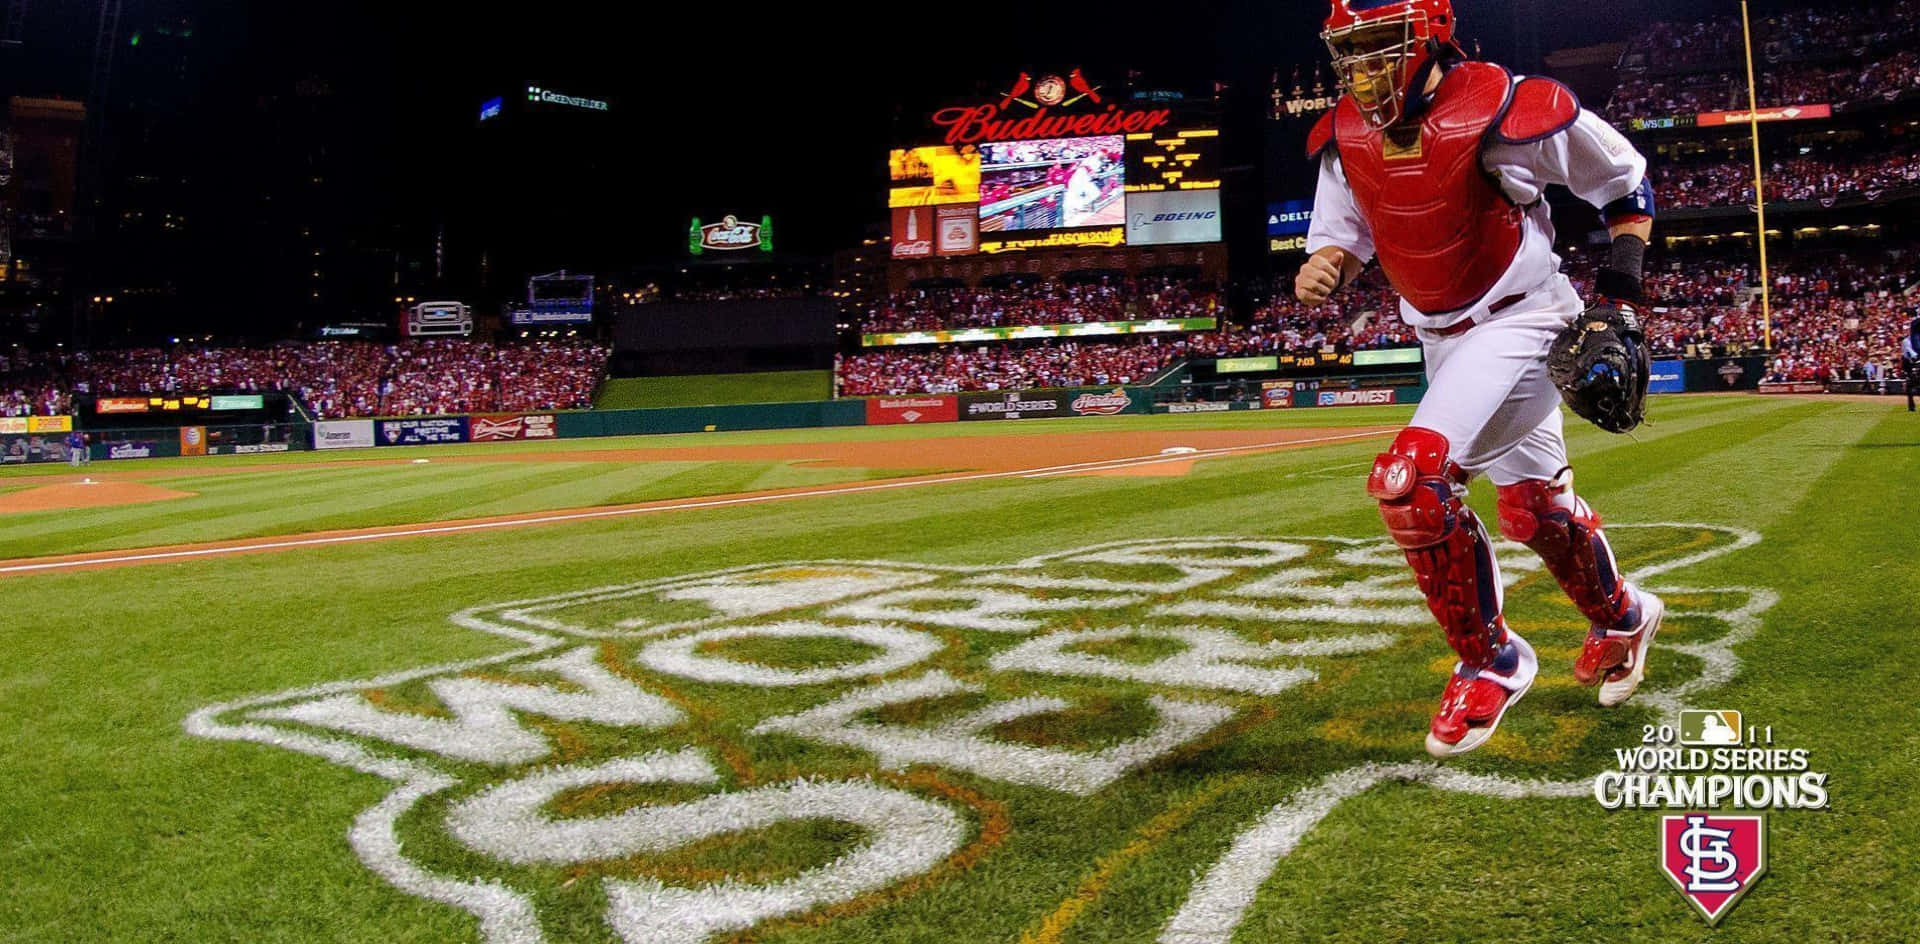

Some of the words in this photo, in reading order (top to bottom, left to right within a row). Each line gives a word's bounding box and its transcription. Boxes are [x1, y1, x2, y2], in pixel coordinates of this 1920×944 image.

[1286, 96, 1337, 114] WORL
[932, 103, 1169, 143] Budweiser
[1153, 210, 1216, 222] BOEING
[968, 401, 1014, 414] #WORLD
[1016, 400, 1057, 412] SERIES
